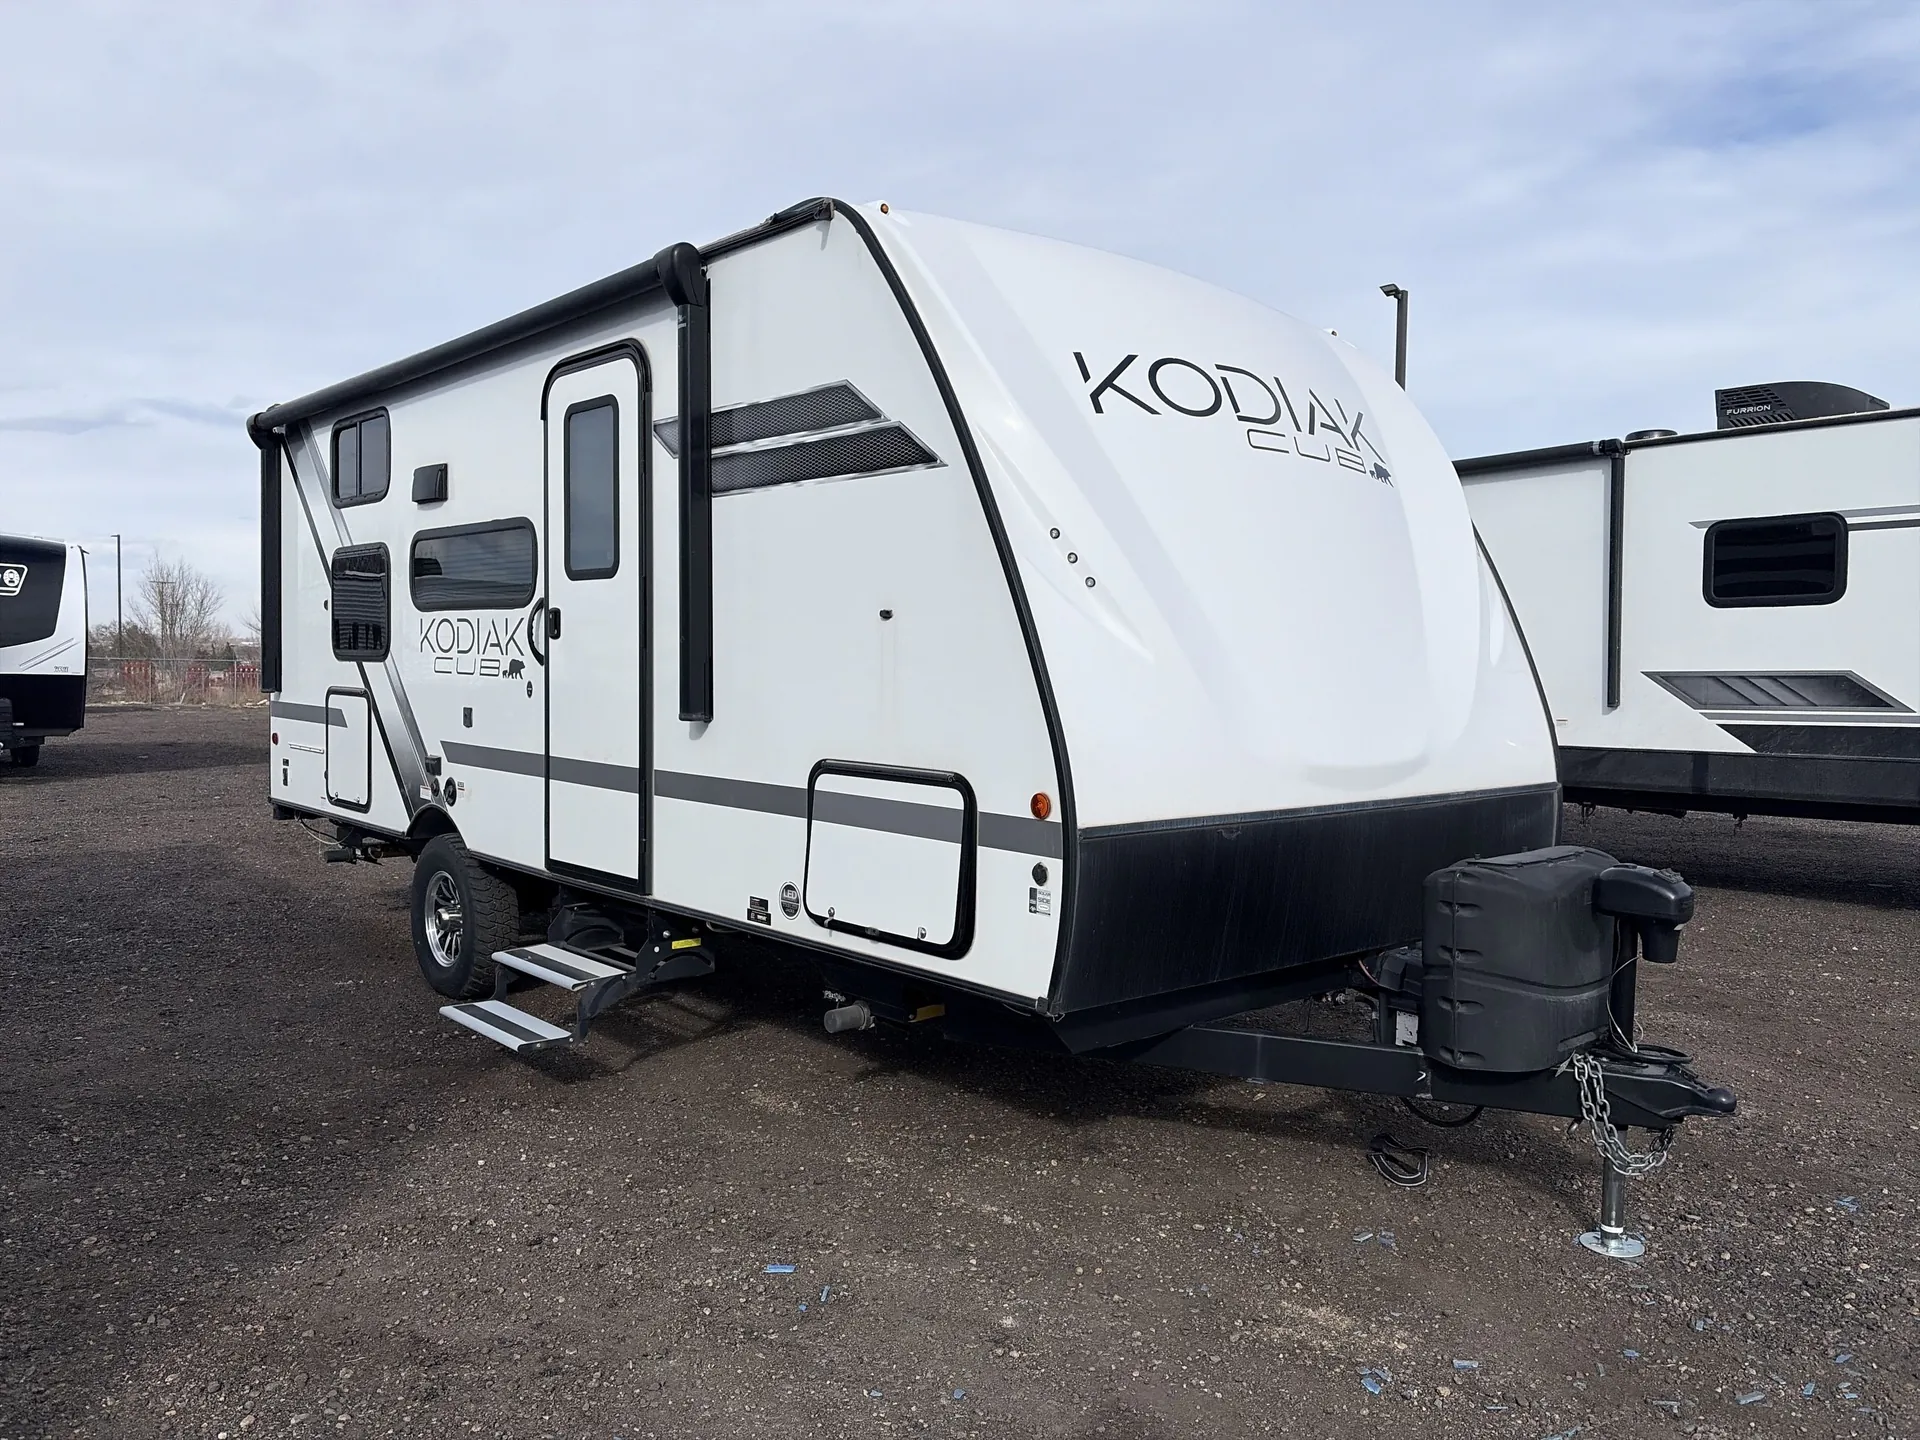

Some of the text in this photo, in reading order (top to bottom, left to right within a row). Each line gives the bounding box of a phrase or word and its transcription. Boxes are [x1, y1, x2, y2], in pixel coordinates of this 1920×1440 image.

[1073, 351, 1386, 465] KODIAK
[1726, 404, 1771, 416] FURRION
[1247, 429, 1367, 474] CUB
[420, 617, 525, 656] KODIAK
[434, 656, 501, 677] CUB
[783, 888, 798, 900] LED
